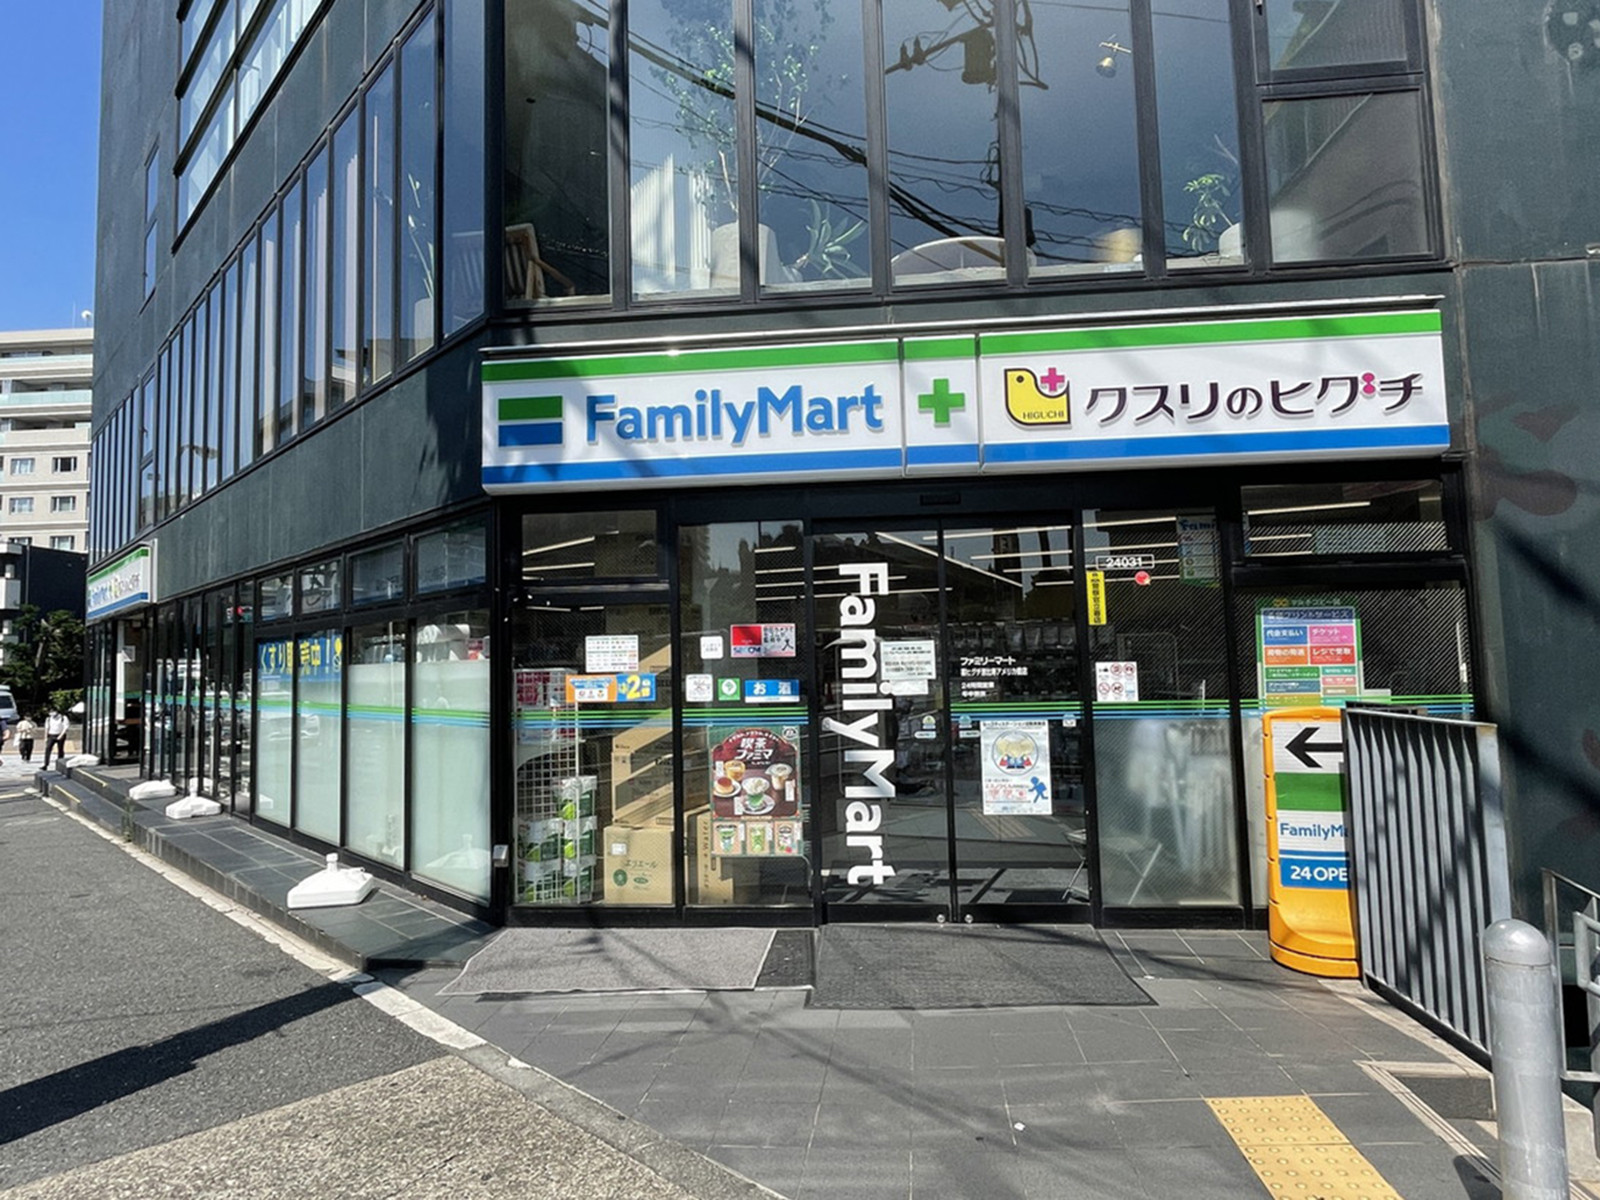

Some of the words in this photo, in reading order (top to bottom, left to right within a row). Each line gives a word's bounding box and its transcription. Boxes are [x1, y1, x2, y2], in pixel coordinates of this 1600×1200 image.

[1086, 372, 1423, 423] クスリのヒグチ
[587, 384, 882, 444] FamilyMart
[1022, 410, 1065, 420] HIGUCHI
[1106, 557, 1142, 567] 24031
[960, 656, 1016, 666] ファミリーマート
[822, 562, 897, 885] FamilyMart
[734, 749, 773, 760] ファミマ
